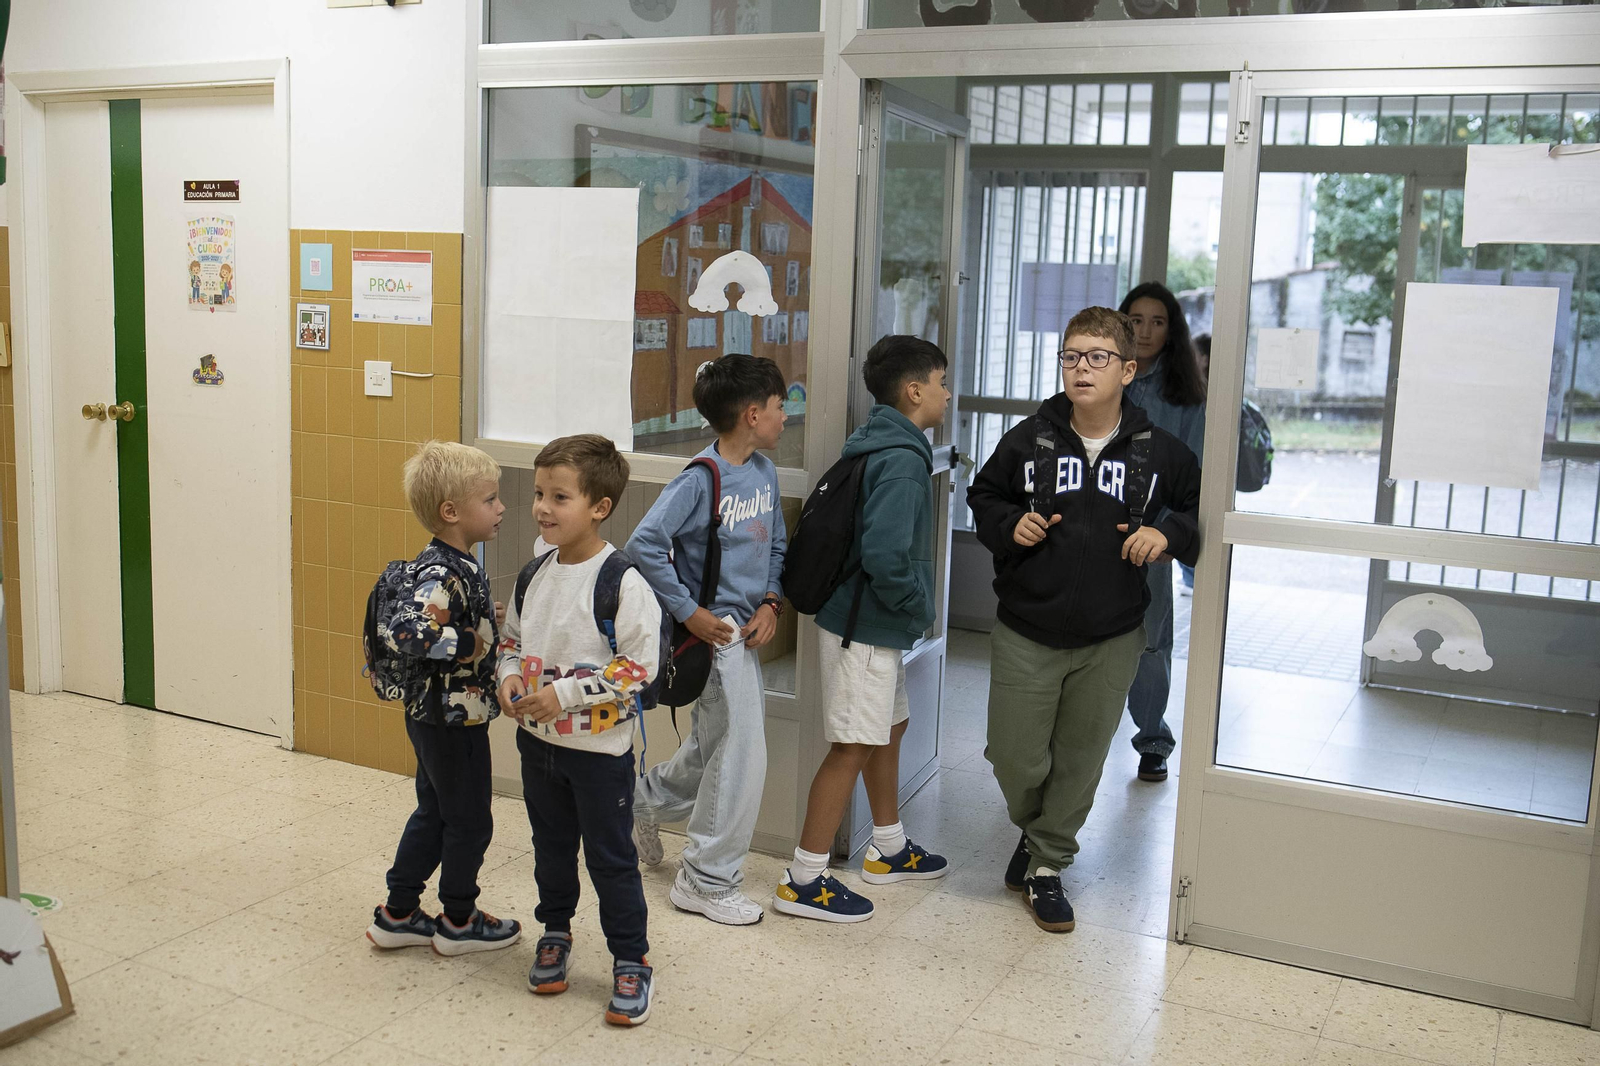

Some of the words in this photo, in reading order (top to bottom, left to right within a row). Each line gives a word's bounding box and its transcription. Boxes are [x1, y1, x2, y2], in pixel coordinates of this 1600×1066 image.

[187, 190, 213, 198] EDUCACIÓN
[197, 243, 223, 254] CURSO
[369, 277, 413, 293] PROA+
